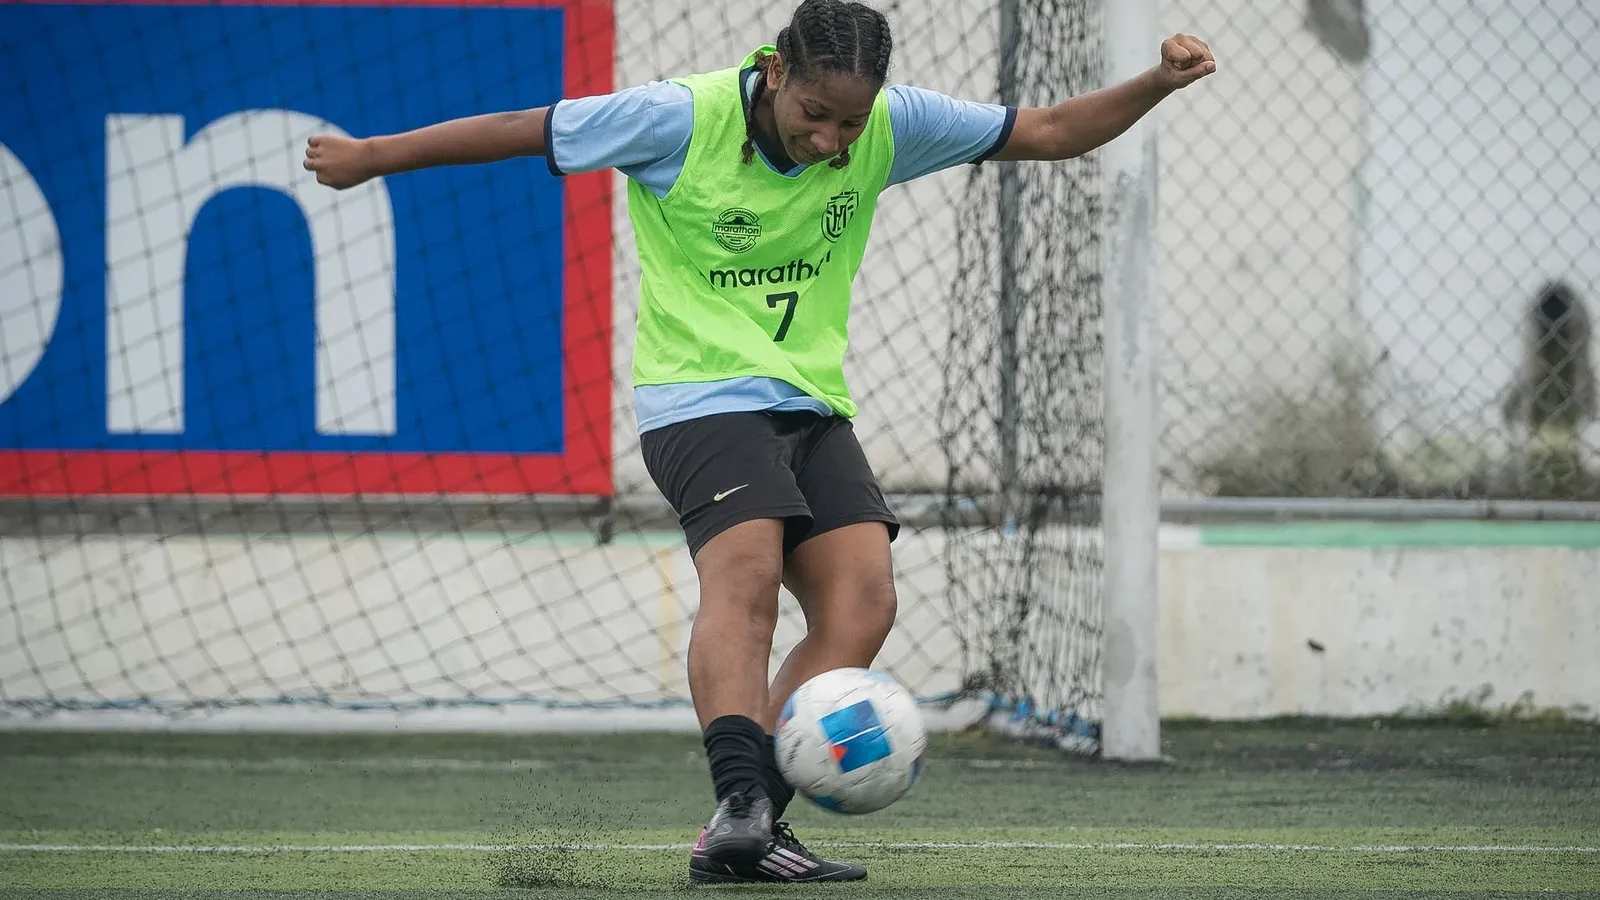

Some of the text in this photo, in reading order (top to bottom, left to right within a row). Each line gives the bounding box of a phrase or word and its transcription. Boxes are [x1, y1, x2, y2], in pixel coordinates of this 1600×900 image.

[715, 225, 759, 235] marathon
[0, 108, 397, 436] n
[709, 250, 831, 288] marath
[766, 291, 799, 342] 7
